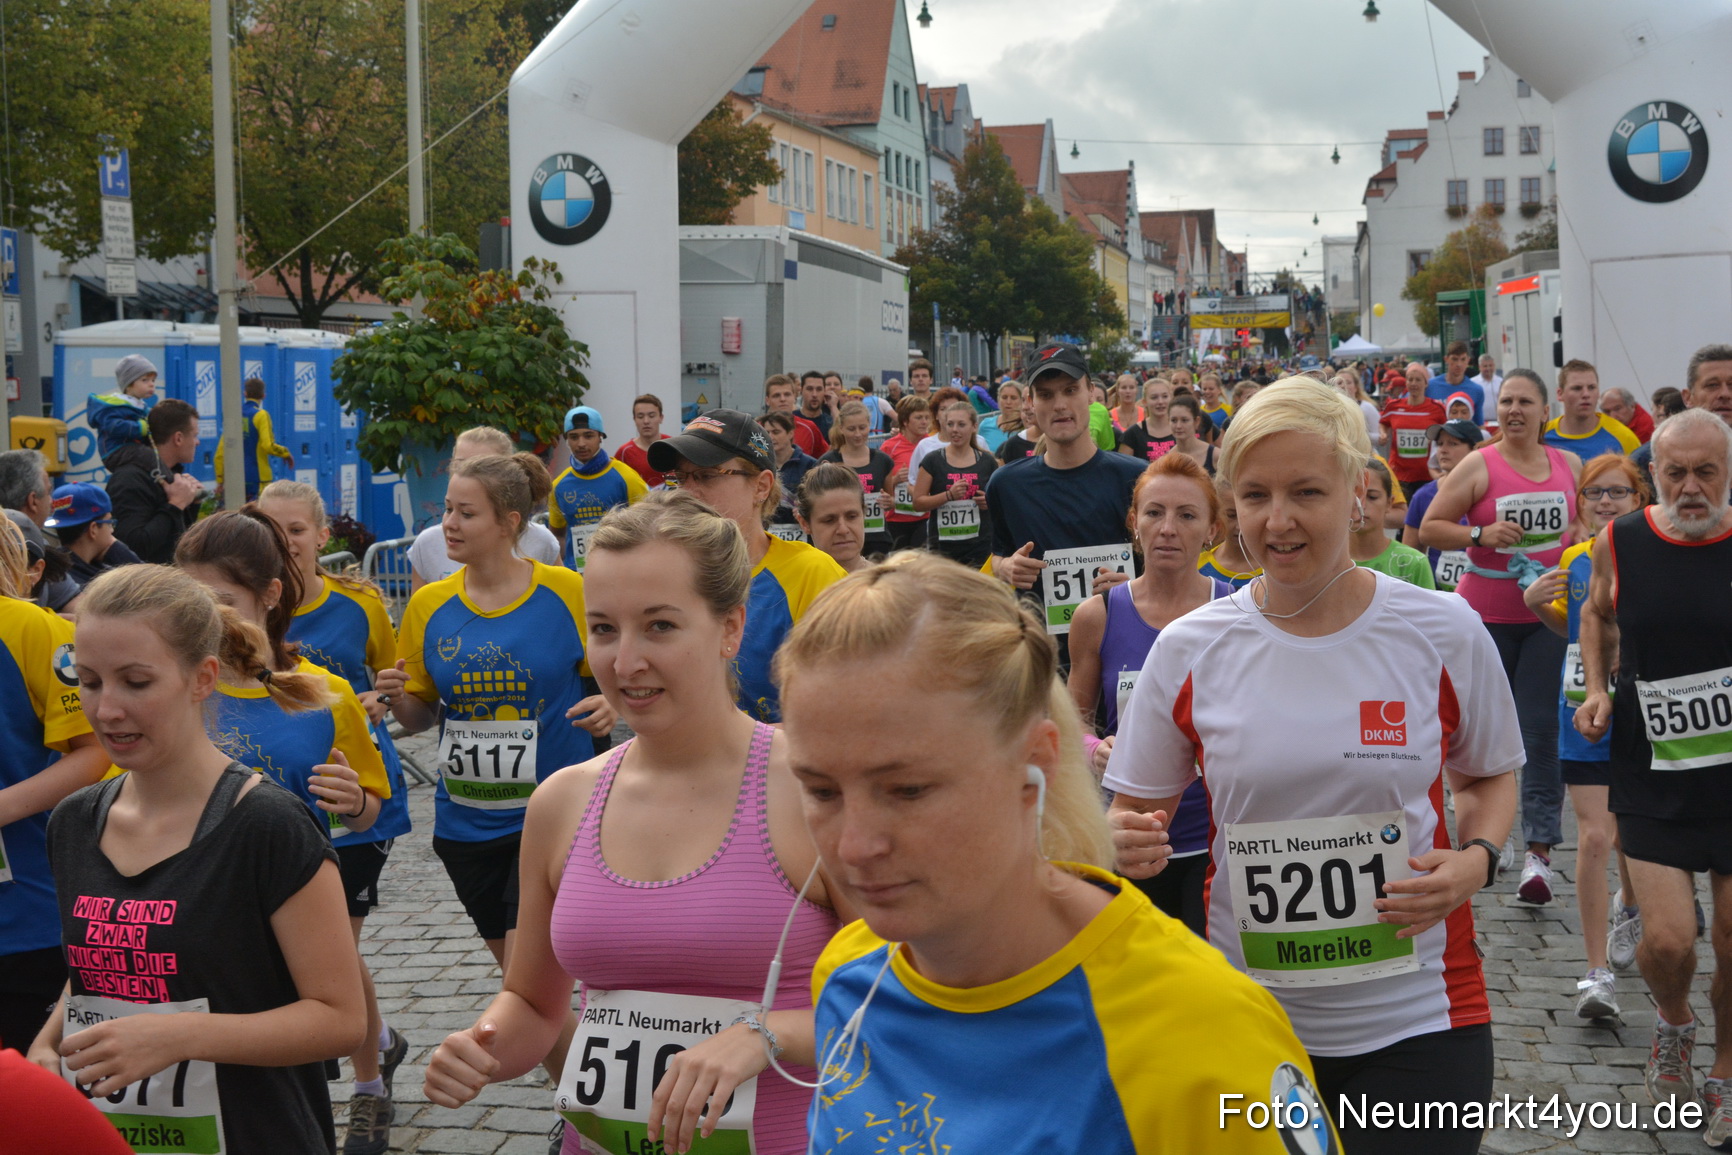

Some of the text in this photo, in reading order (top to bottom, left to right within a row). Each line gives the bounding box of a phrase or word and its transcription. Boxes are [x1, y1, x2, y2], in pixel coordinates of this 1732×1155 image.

[1615, 102, 1701, 139] BMW
[533, 155, 604, 186] BMW
[1222, 315, 1257, 325] START
[1400, 436, 1426, 447] 5187
[941, 510, 975, 526] 5071
[1505, 507, 1562, 531] 5048
[1075, 553, 1119, 564] Neumarkt
[1668, 681, 1718, 697] Neumarkt
[1647, 693, 1732, 736] 5500
[471, 730, 518, 739] Neumarkt
[1364, 729, 1404, 742] DKMS
[447, 743, 526, 779] 5117
[1357, 752, 1389, 760] besiegen
[1391, 752, 1422, 761] Blutkrebs.
[463, 784, 519, 798] Christina
[1228, 832, 1374, 855] PARTL Neumarkt
[1245, 853, 1389, 924] 5201
[74, 897, 175, 923] WIR SIND
[87, 923, 146, 948] ZWAR
[68, 947, 176, 974] NICHT DIE
[1277, 936, 1372, 964] Mareike
[81, 972, 169, 1001] BESTEN,
[582, 1009, 721, 1035] PARTL Neumarkt
